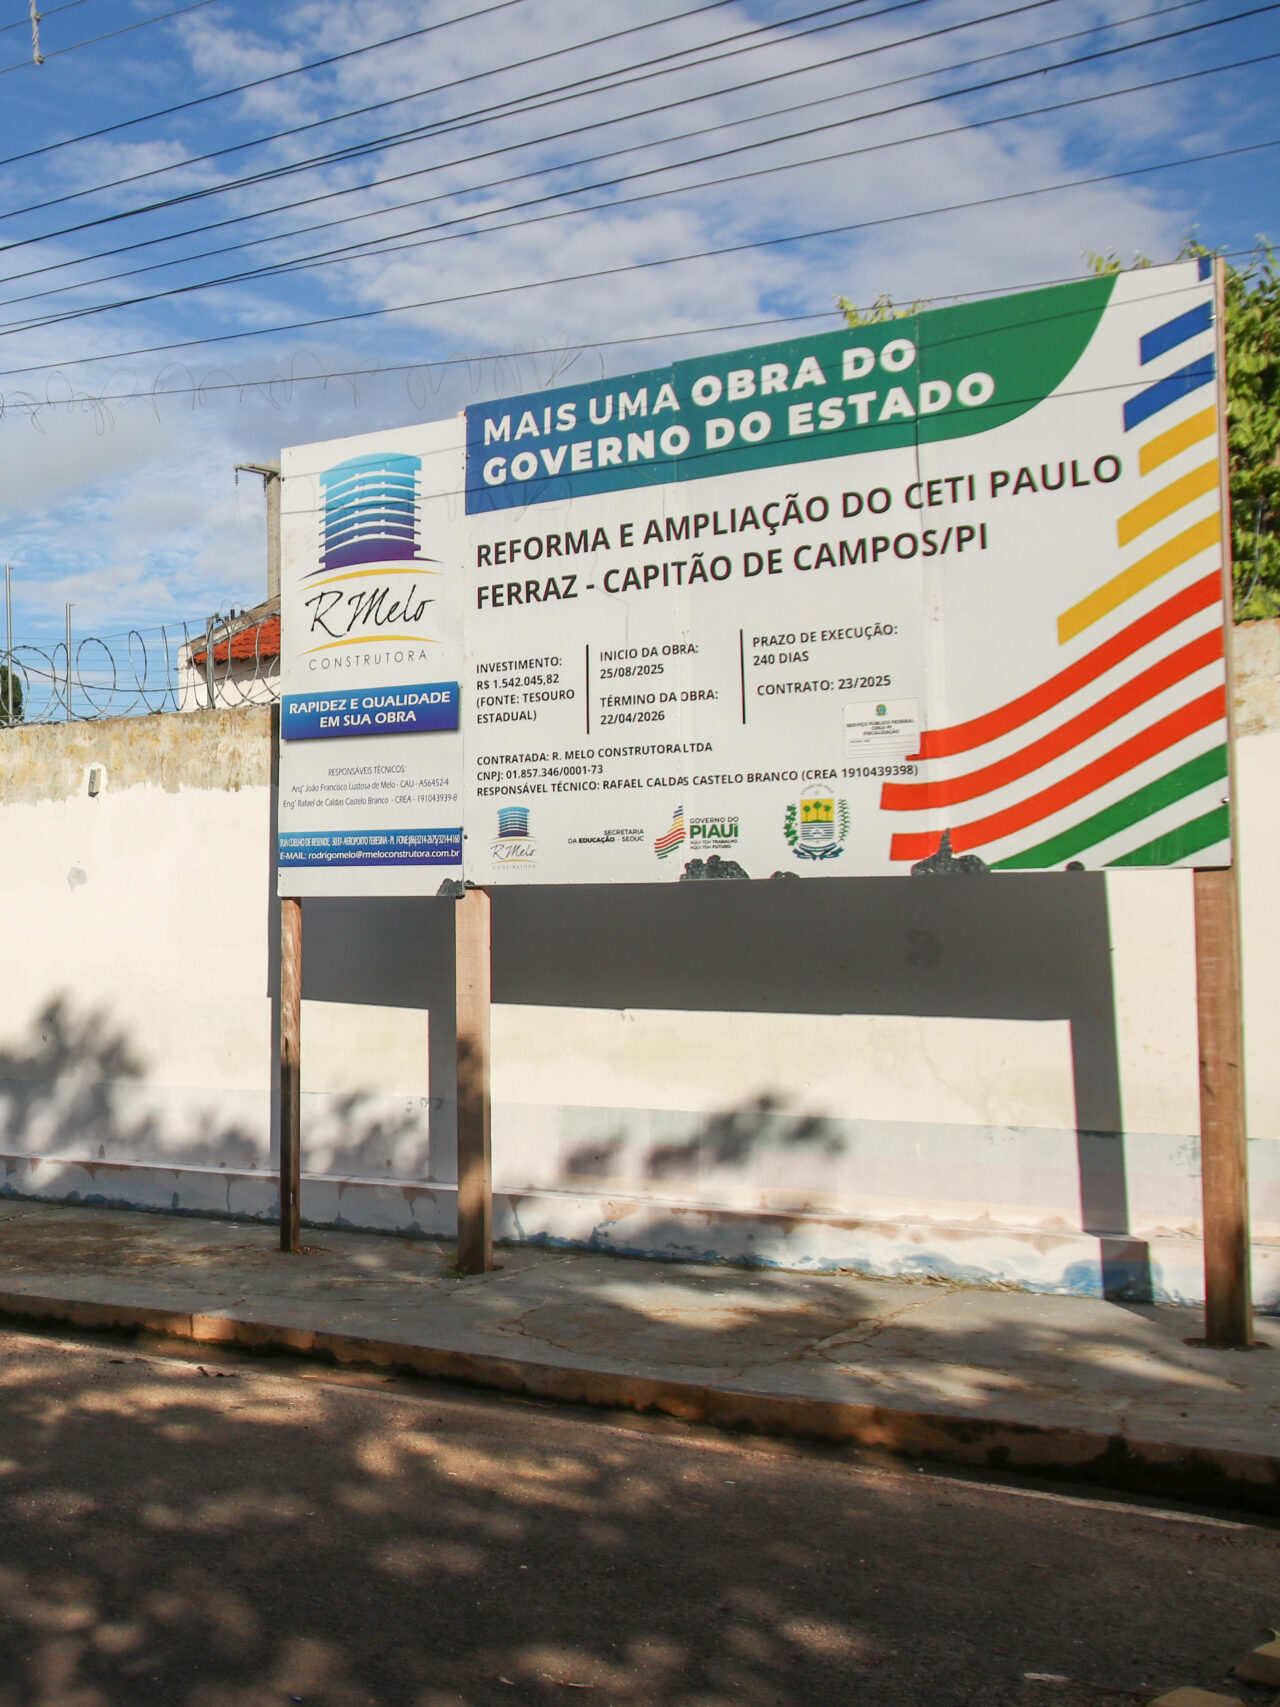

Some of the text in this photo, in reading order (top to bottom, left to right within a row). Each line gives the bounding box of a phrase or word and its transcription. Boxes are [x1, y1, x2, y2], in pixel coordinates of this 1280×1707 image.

[484, 338, 916, 446] MAIS UMA OBRA DO
[483, 372, 995, 486] GOVERNO DO ESTADO
[477, 454, 1122, 567] REFORMA E AMPLIAÇÃO DO CETI PAULO
[477, 574, 578, 609] FERRAZ
[603, 552, 732, 594] CAPITÃO
[744, 548, 782, 578] DE
[794, 522, 988, 571] CAMPOS/PI
[752, 622, 898, 648] PRAZO DE EXECUÇÃO:
[308, 650, 426, 670] CONSTRUTORA
[600, 644, 698, 662] INICIO DA OBRA:
[753, 651, 809, 666] 240 DIAS
[476, 656, 562, 674] INVESTIMENTO:
[600, 664, 664, 678] 25/08/2025
[476, 674, 560, 690] R$ 1.542.045,82
[757, 674, 892, 696] CONTRATO: 23/2025
[289, 691, 450, 714] RAPIDEZ E QUALIDADE
[476, 689, 574, 708] (FONTE: TESOURO
[600, 689, 718, 708] TÉRMINO DA OBRA:
[320, 711, 416, 728] EM SUA OBRA
[477, 710, 536, 724] ESTADUAL)
[600, 710, 665, 725] 22/04/2026
[477, 742, 712, 766] CONTRATADA: R. MELO CONSTRUTORA LTDA
[328, 764, 406, 776] RESPONSÁVEIS TÉCNICOS:
[477, 764, 604, 782] CNPJ: 01.857.346/0001-73
[305, 784, 319, 792] João
[320, 783, 348, 792] Francisco
[348, 782, 370, 790] Lustosa
[372, 782, 378, 790] de
[379, 780, 396, 789] Melo
[400, 780, 414, 788] CAU
[419, 778, 449, 788] A56452-4
[477, 764, 918, 796] RESPONSÁVEL TÉCNICO: RAFAEL CALDAS CASTELO BRANCO (CREA 1910439398)
[298, 799, 316, 807] Rafael
[317, 798, 324, 806] de
[325, 798, 344, 806] Caldas
[346, 797, 366, 806] Castelo
[368, 796, 388, 804] Branco
[395, 795, 412, 804] CREA
[604, 828, 644, 836] SECRETARIA
[690, 823, 738, 838] PIAUÍ
[578, 836, 615, 844] EDUCAÇÃO
[280, 850, 460, 862] E-MAIL: rodrigomelo@rmeloconstrutora.com.br
